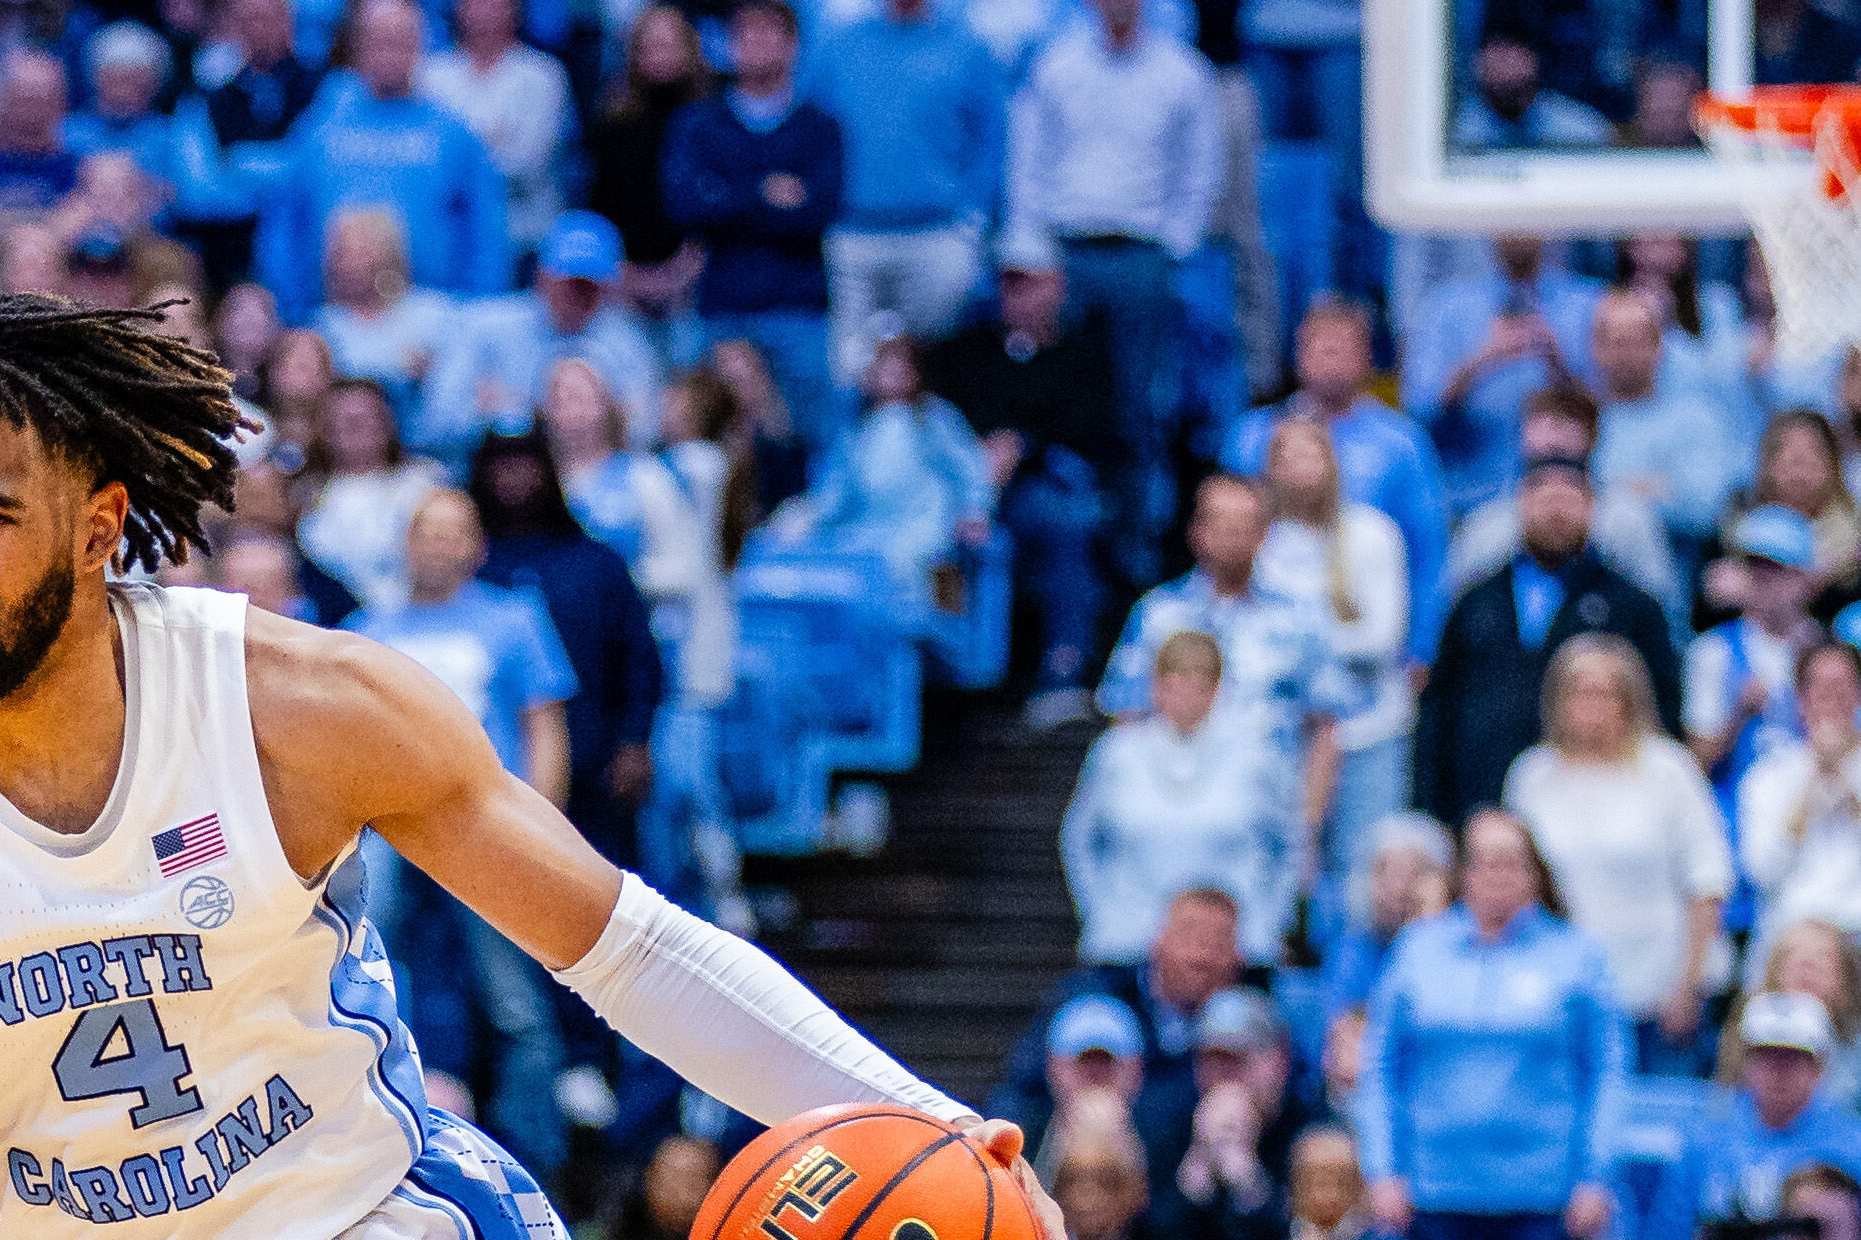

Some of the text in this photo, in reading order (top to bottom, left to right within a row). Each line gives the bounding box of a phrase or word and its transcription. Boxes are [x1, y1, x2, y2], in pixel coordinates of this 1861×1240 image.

[189, 888, 230, 909] ACC
[51, 997, 204, 1130] 4
[7, 1074, 314, 1224] CAROLINA
